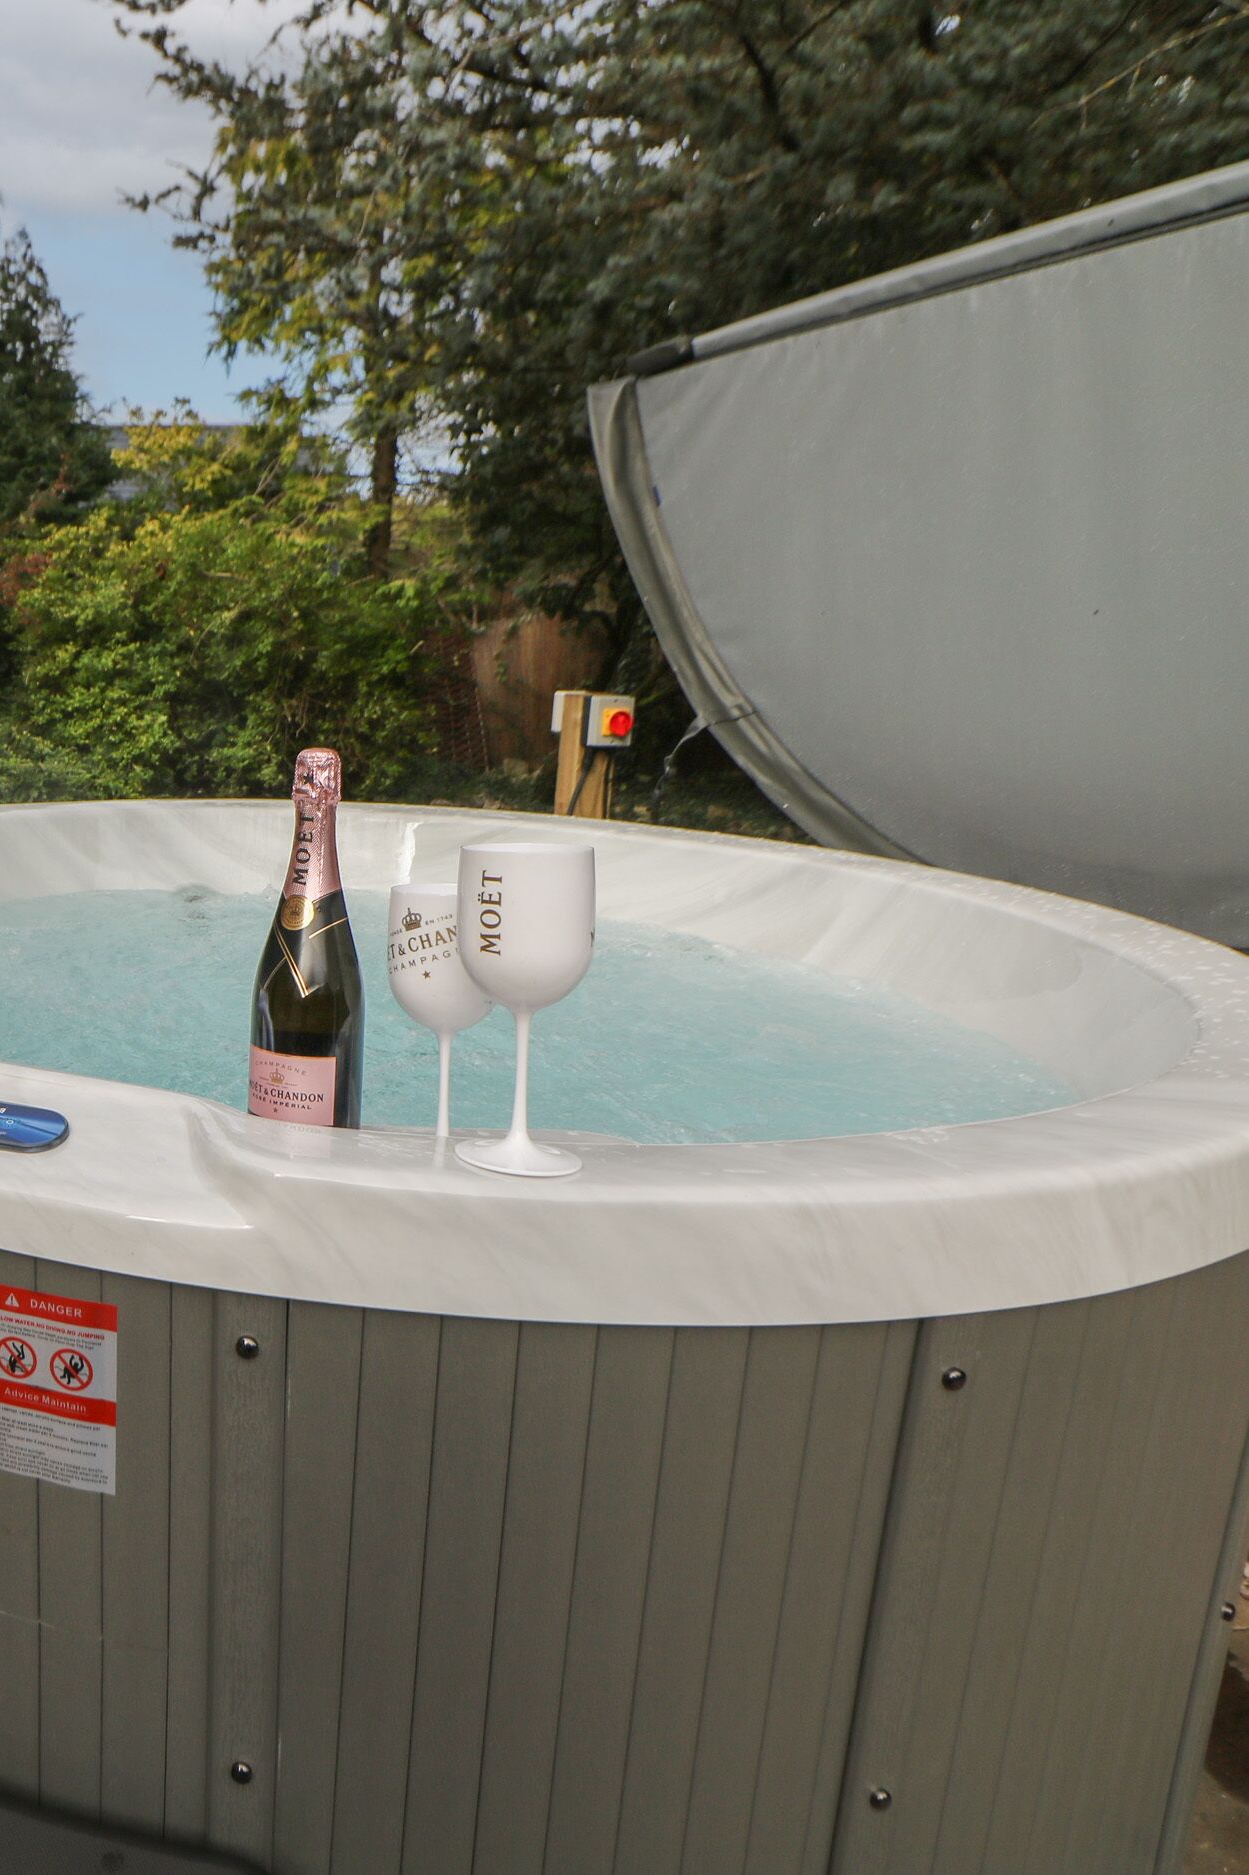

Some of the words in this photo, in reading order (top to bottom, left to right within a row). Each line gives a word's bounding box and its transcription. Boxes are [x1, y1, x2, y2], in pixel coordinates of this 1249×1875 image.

[478, 869, 502, 956] MOËT
[398, 943, 406, 956] &
[255, 1060, 308, 1076] CHAMPAGNE
[270, 1088, 325, 1103] CHANDON
[30, 1298, 83, 1317] DANGER
[77, 1330, 105, 1341] JUMPING
[4, 1387, 39, 1401] Advice
[42, 1395, 86, 1413] Maintain
